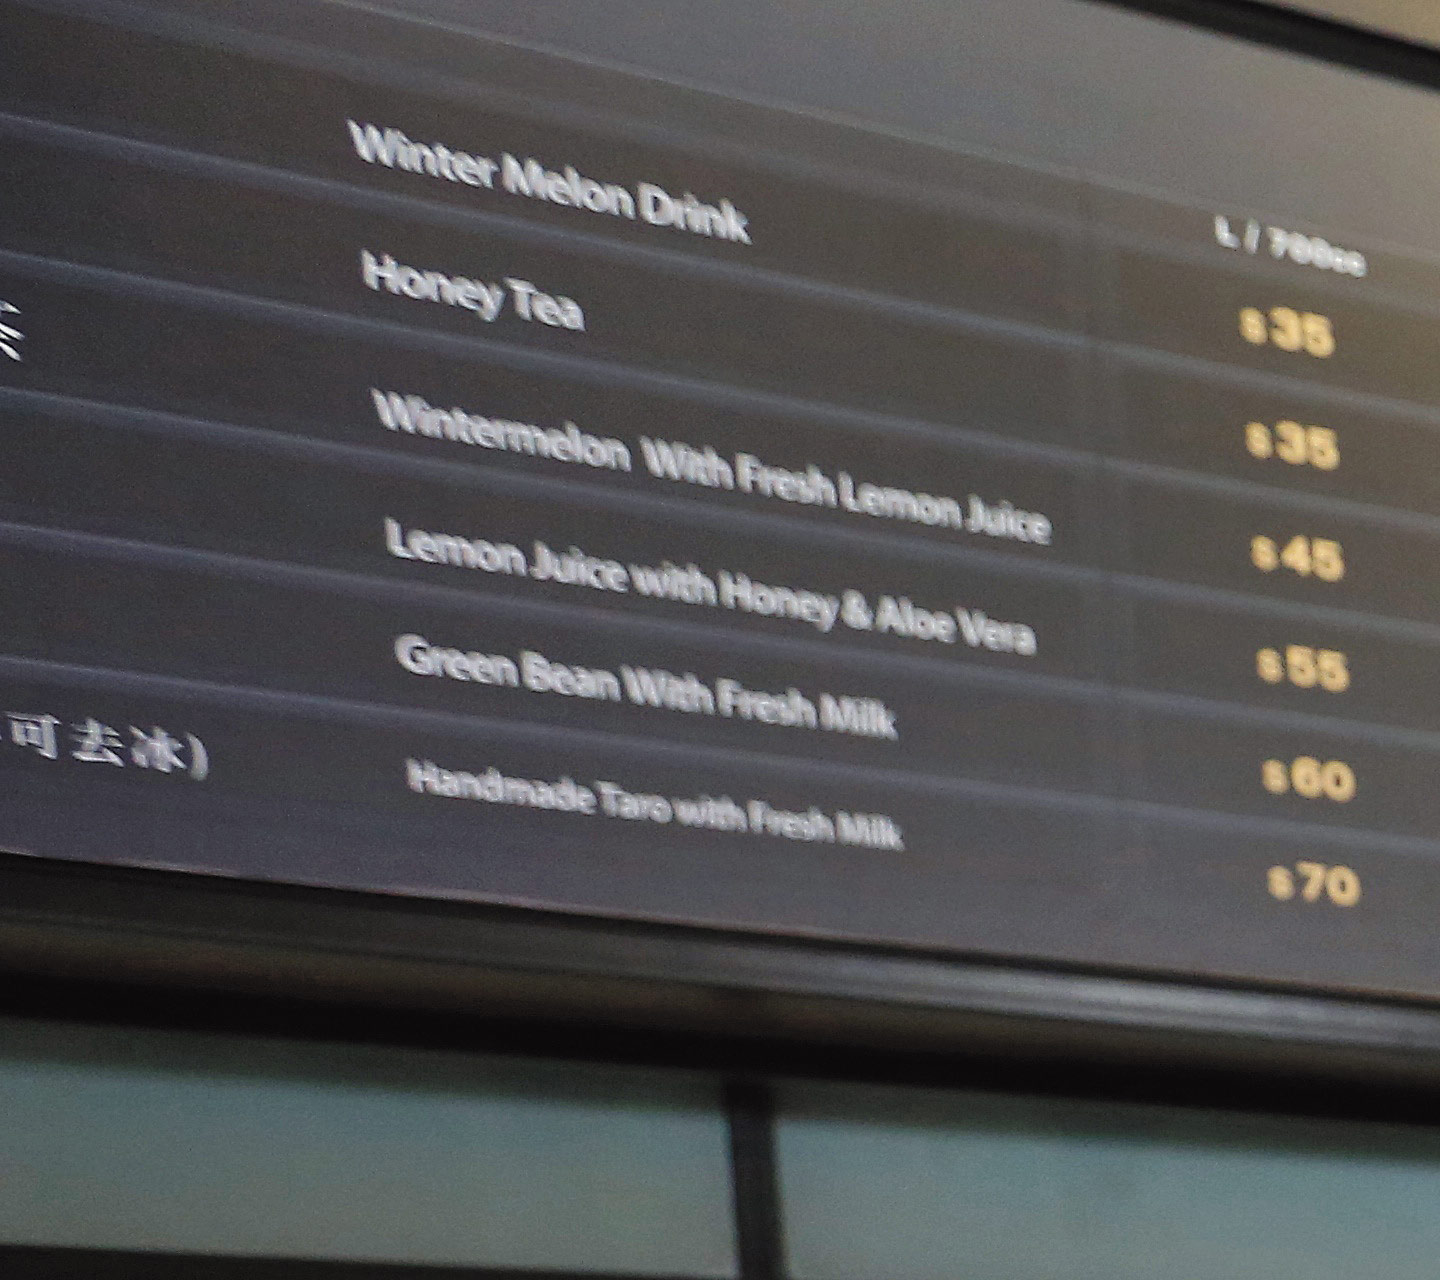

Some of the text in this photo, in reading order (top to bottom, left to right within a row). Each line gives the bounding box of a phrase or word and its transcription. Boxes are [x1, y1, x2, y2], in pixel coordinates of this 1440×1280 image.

[349, 122, 748, 242] Winter Melon Drink
[363, 252, 583, 329] Honey Tea
[374, 391, 1050, 543] Wintermelon With Fresh Lemon Juice
[387, 520, 1035, 653] Lemon Juice with Honey & Aloe Vera
[397, 636, 896, 736] Green Bean With Fresh Milk
[409, 763, 901, 847] Handmade Taro with Fresh Milk
